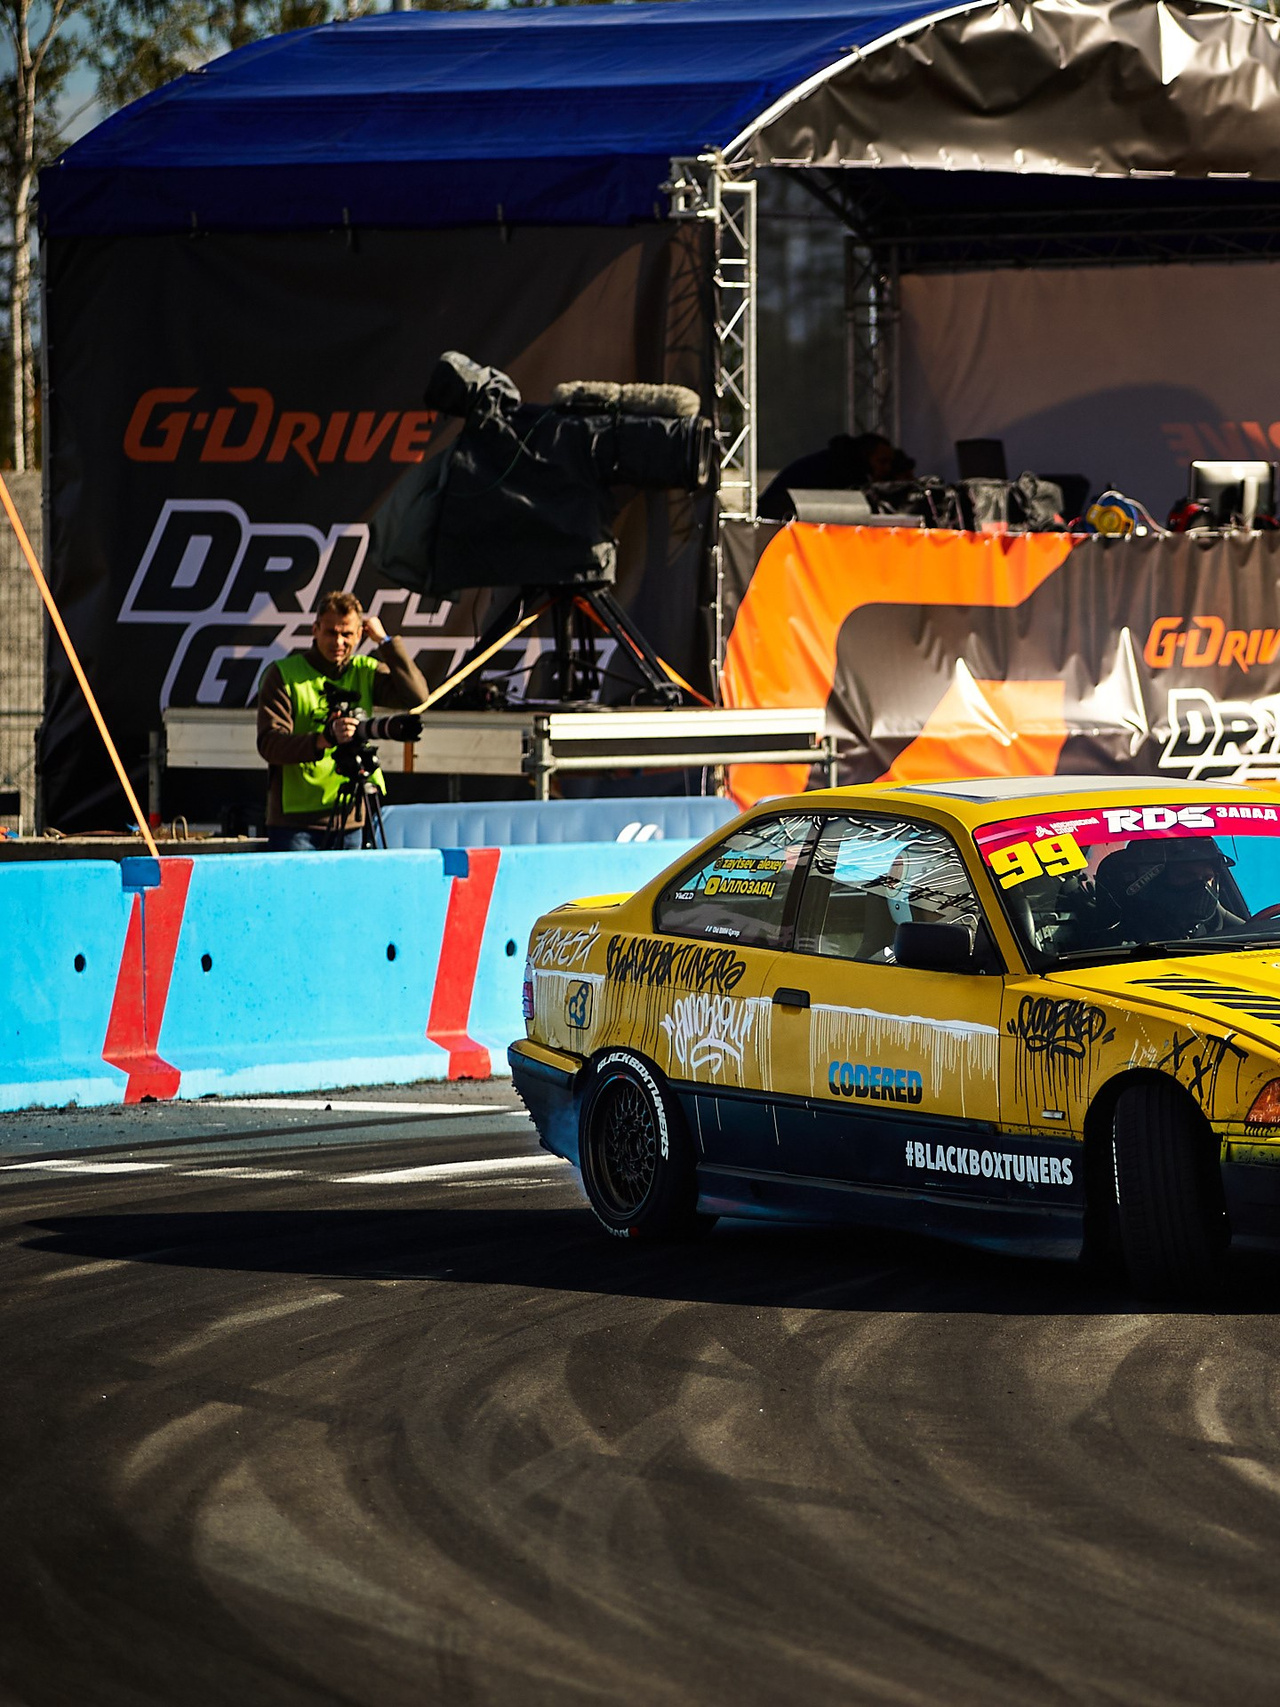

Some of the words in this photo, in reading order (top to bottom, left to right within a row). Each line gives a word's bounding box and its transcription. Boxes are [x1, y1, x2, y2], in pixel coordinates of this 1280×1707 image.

[1102, 807, 1215, 833] RDS
[1216, 806, 1278, 821] ЗАПАД
[988, 833, 1089, 889] 99
[718, 879, 776, 898] АЛЛОЗАЯЦ
[828, 1060, 923, 1105] CODERED
[905, 1140, 1074, 1186] #BLACKBOXTUNERS
